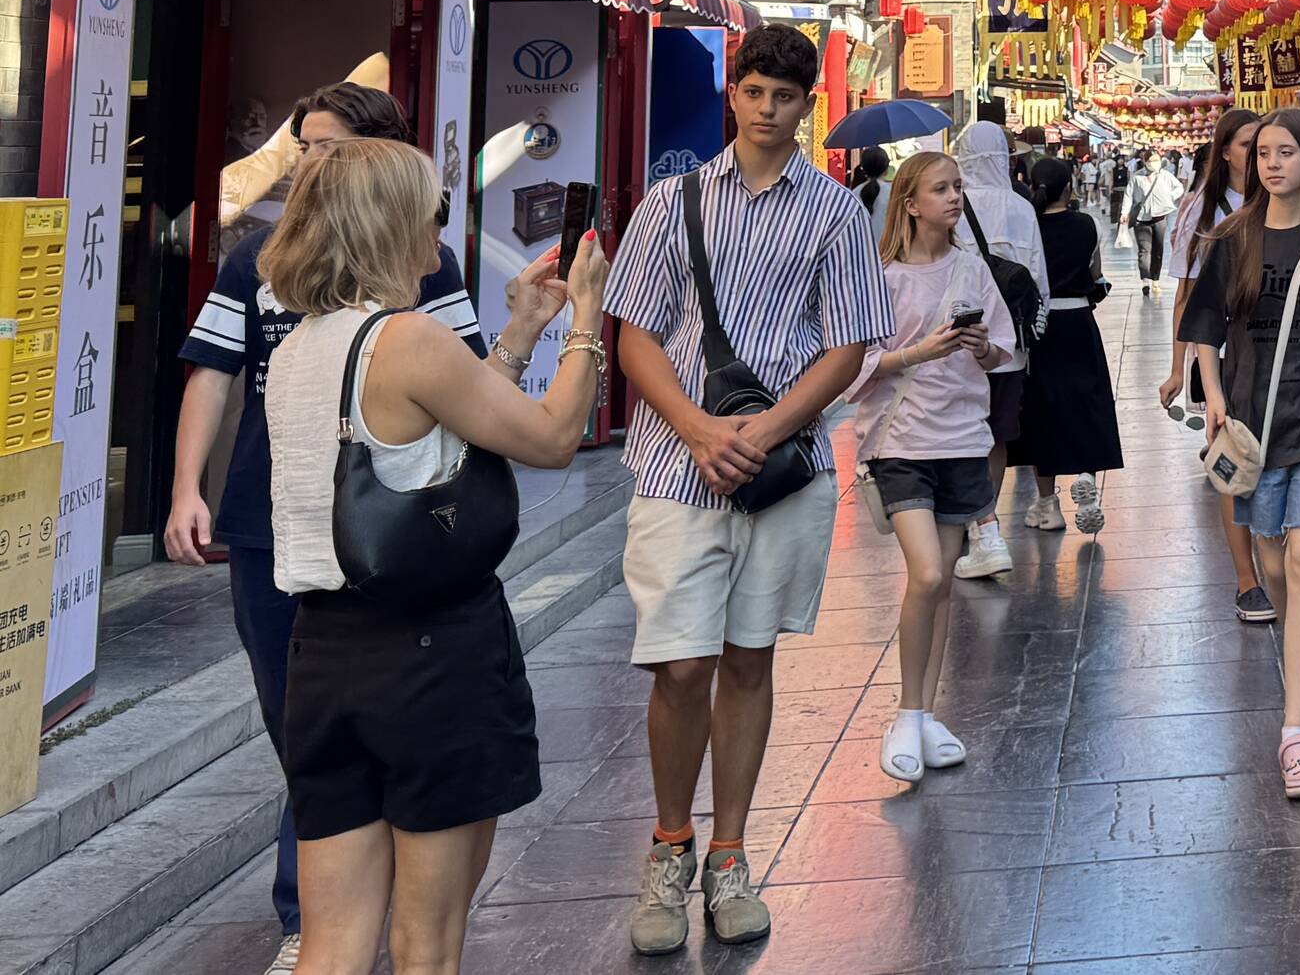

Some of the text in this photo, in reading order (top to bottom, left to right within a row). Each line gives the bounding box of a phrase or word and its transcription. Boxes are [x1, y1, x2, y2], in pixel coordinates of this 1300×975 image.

[89, 16, 125, 38] YUNSHENG
[506, 83, 579, 95] YUNSHENG
[69, 78, 114, 417] 音乐盒
[276, 323, 292, 331] THE
[58, 478, 102, 518] XPENSIVE
[54, 531, 71, 559] IFT
